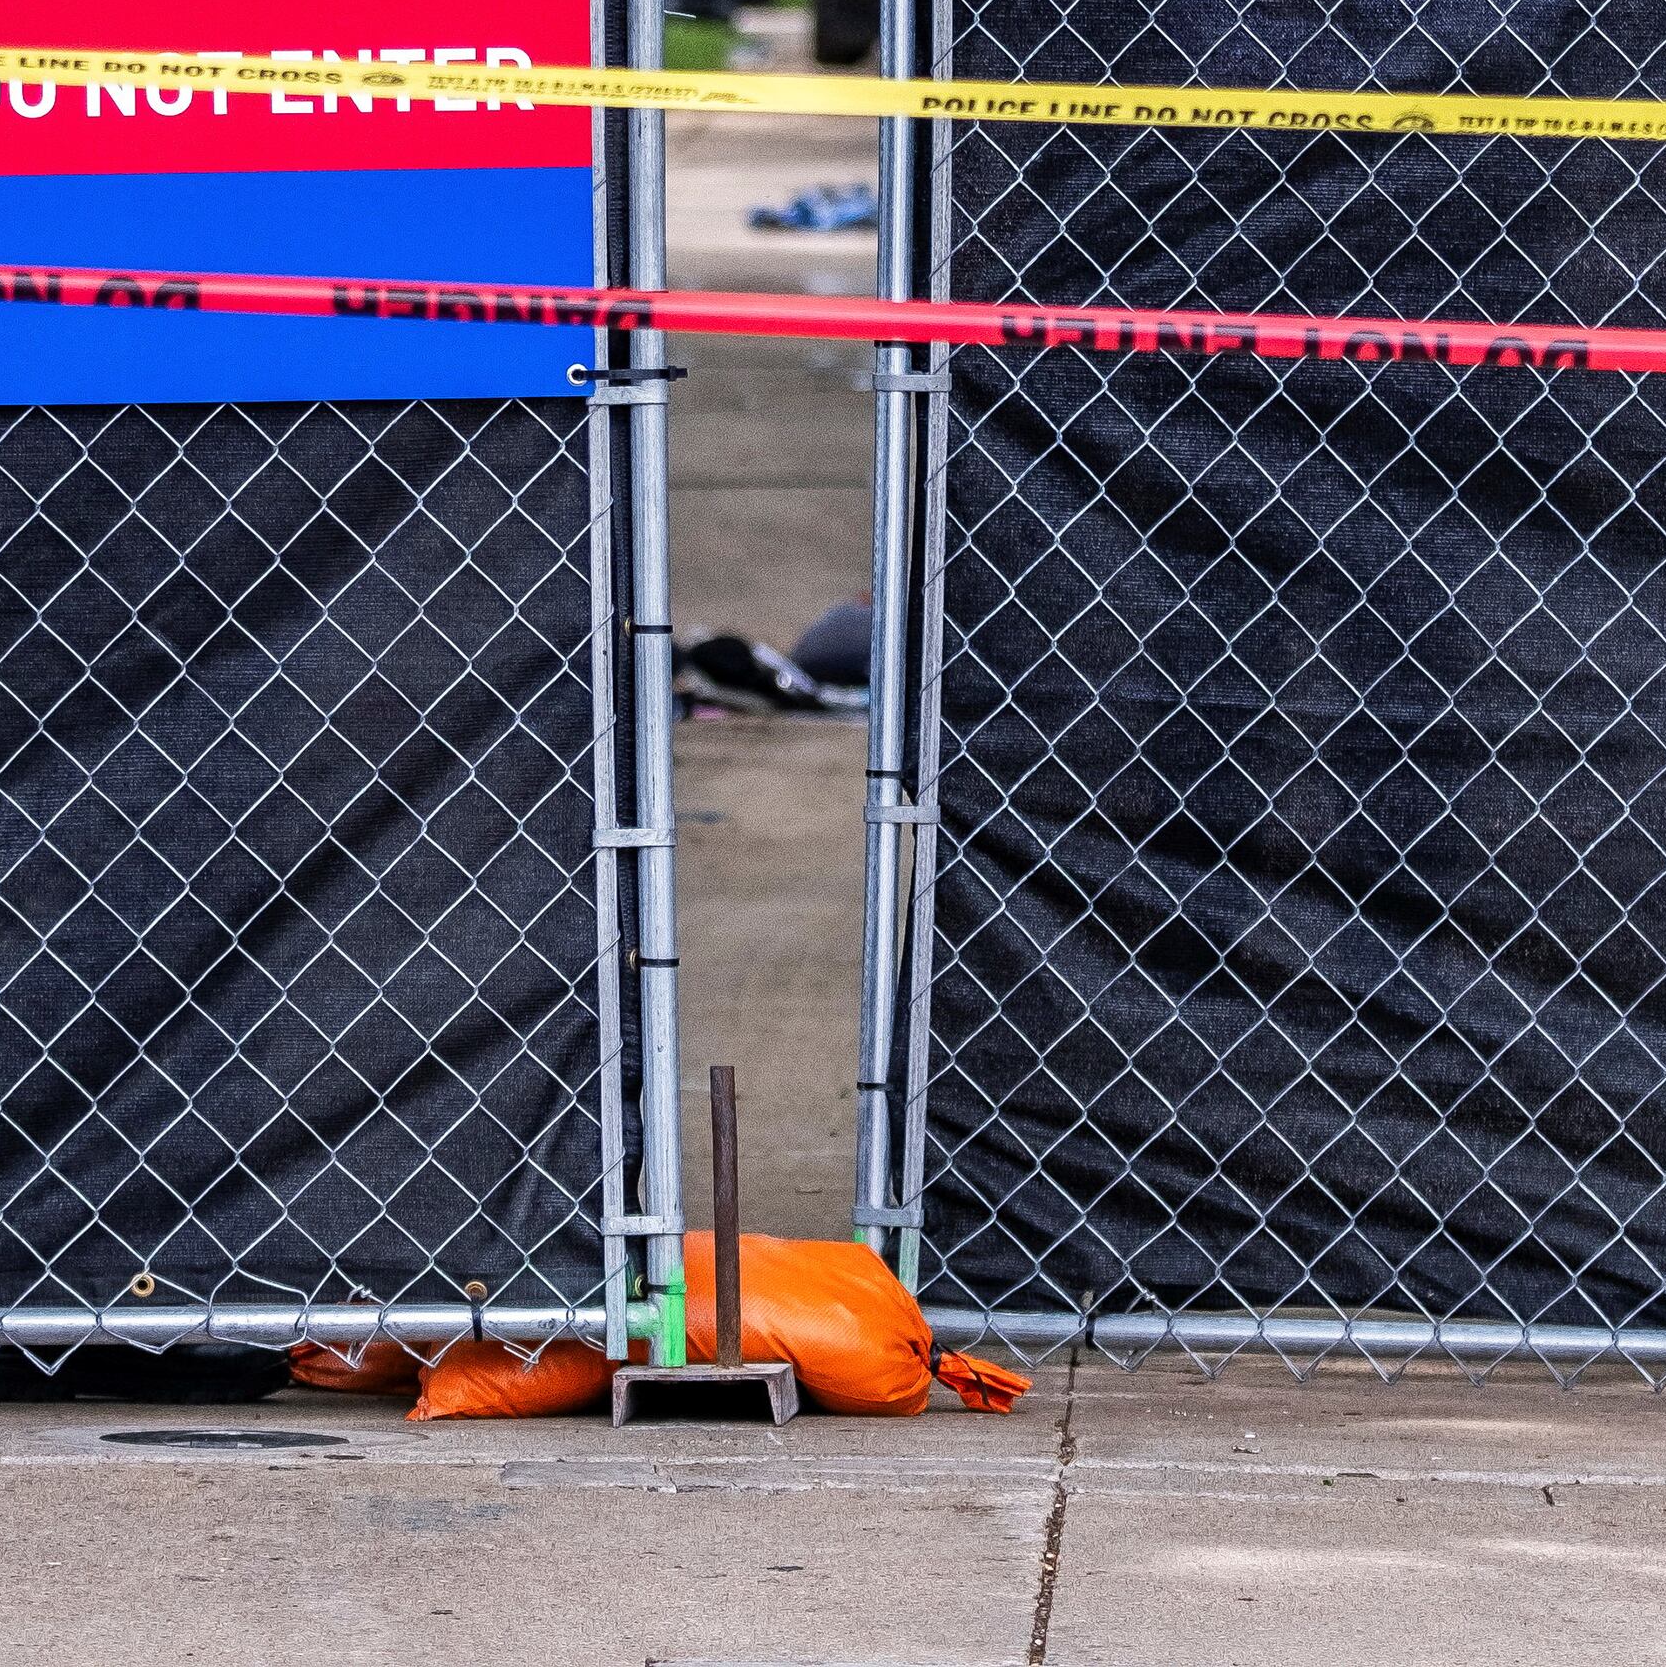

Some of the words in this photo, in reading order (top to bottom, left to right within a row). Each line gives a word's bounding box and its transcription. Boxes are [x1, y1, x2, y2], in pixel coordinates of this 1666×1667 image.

[19, 56, 91, 73] LINE
[104, 61, 147, 75] DO
[160, 62, 224, 79] NOT
[236, 67, 344, 85] CROSS
[271, 46, 537, 116] ENTER
[921, 96, 1038, 117] POLICE
[1049, 101, 1120, 121] LINE
[1133, 105, 1177, 123] DO
[1189, 108, 1253, 126] NOT
[1267, 111, 1374, 131] CROSS
